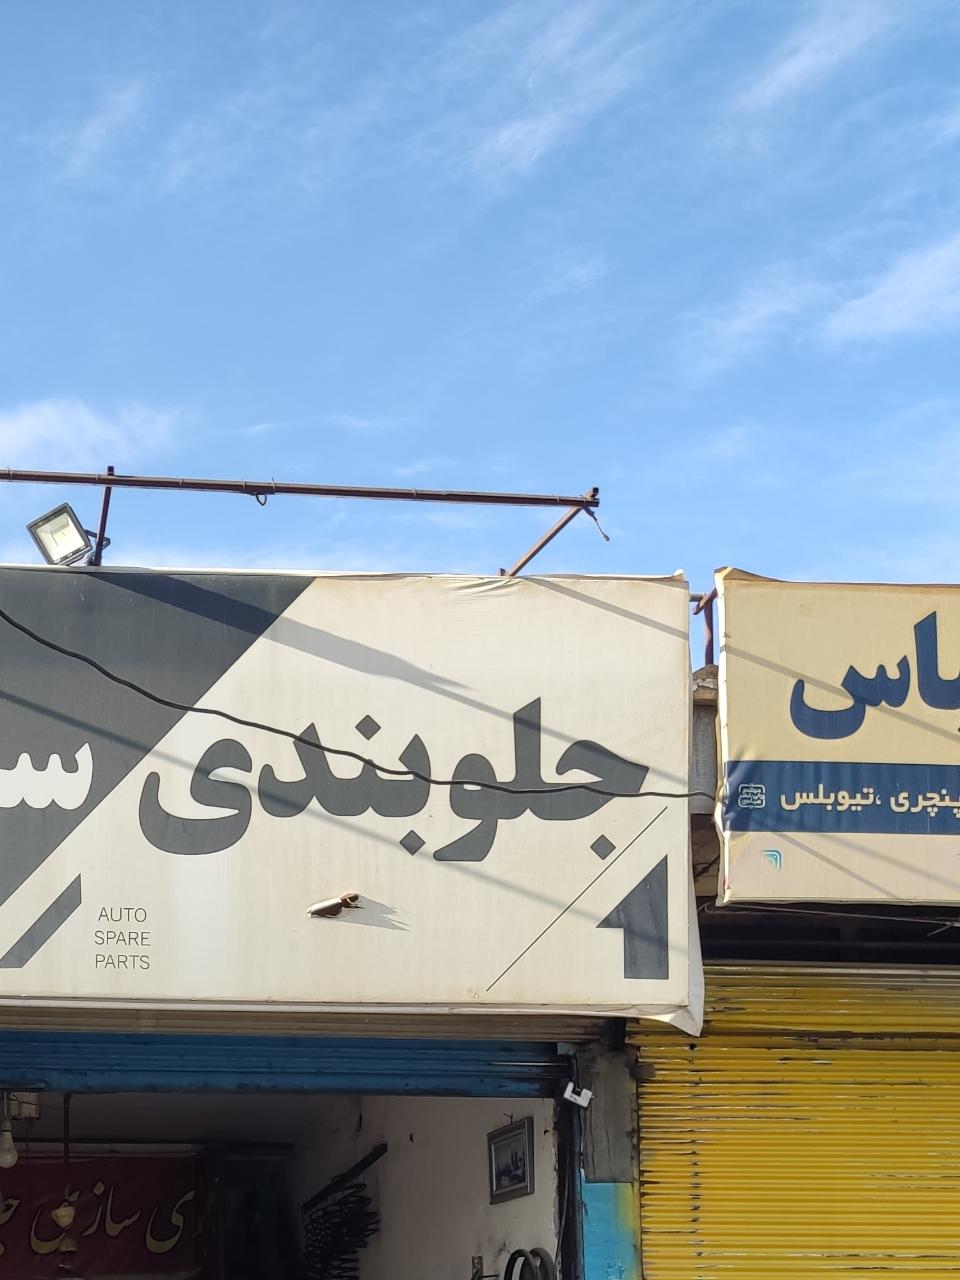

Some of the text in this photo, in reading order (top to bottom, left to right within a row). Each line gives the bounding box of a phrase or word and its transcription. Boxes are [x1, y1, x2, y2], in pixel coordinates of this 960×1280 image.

[138, 697, 650, 862] جلوبندی
[97, 906, 147, 923] AUTO
[94, 930, 151, 946] SPARE
[95, 953, 150, 970] PARTS
